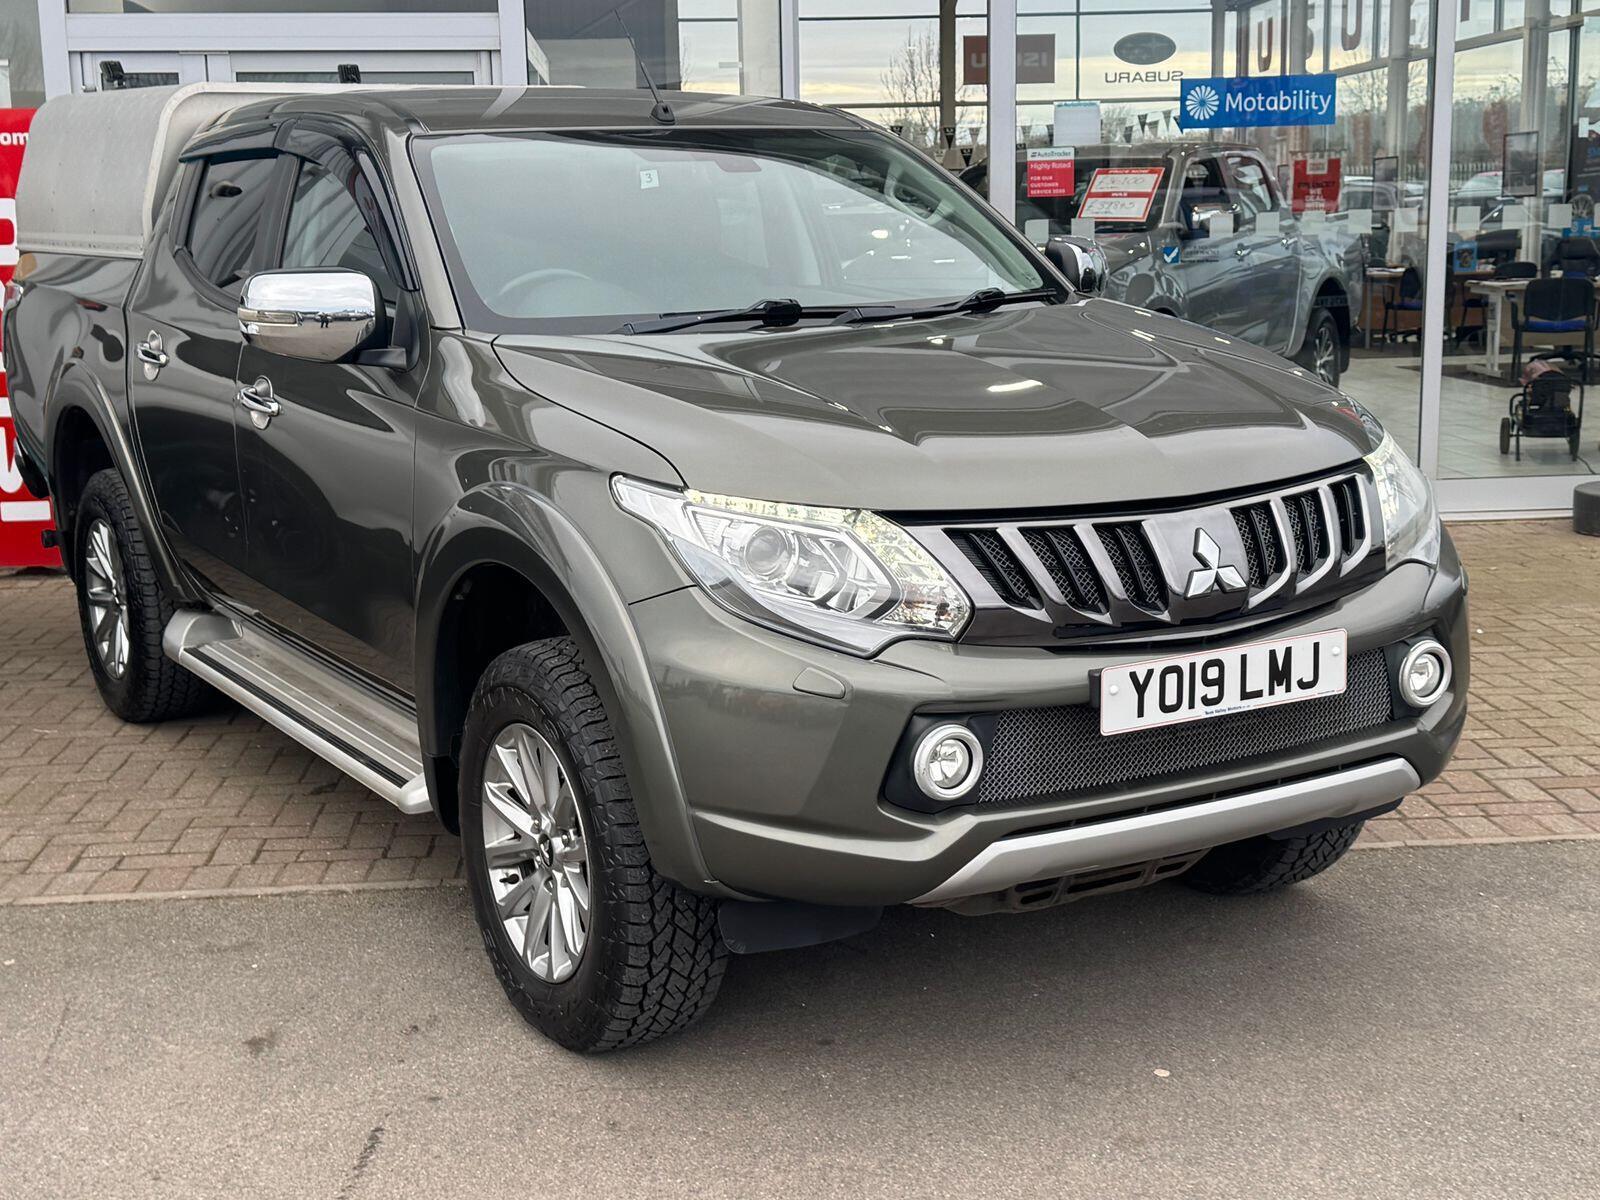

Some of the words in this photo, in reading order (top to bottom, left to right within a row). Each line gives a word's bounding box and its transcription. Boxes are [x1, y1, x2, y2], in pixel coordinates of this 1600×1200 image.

[1225, 89, 1332, 116] Motability
[1030, 162, 1050, 171] Highly
[1051, 161, 1072, 169] Rated
[644, 173, 653, 184] 3
[1129, 658, 1225, 719] YO19
[1239, 641, 1321, 701] LMJ
